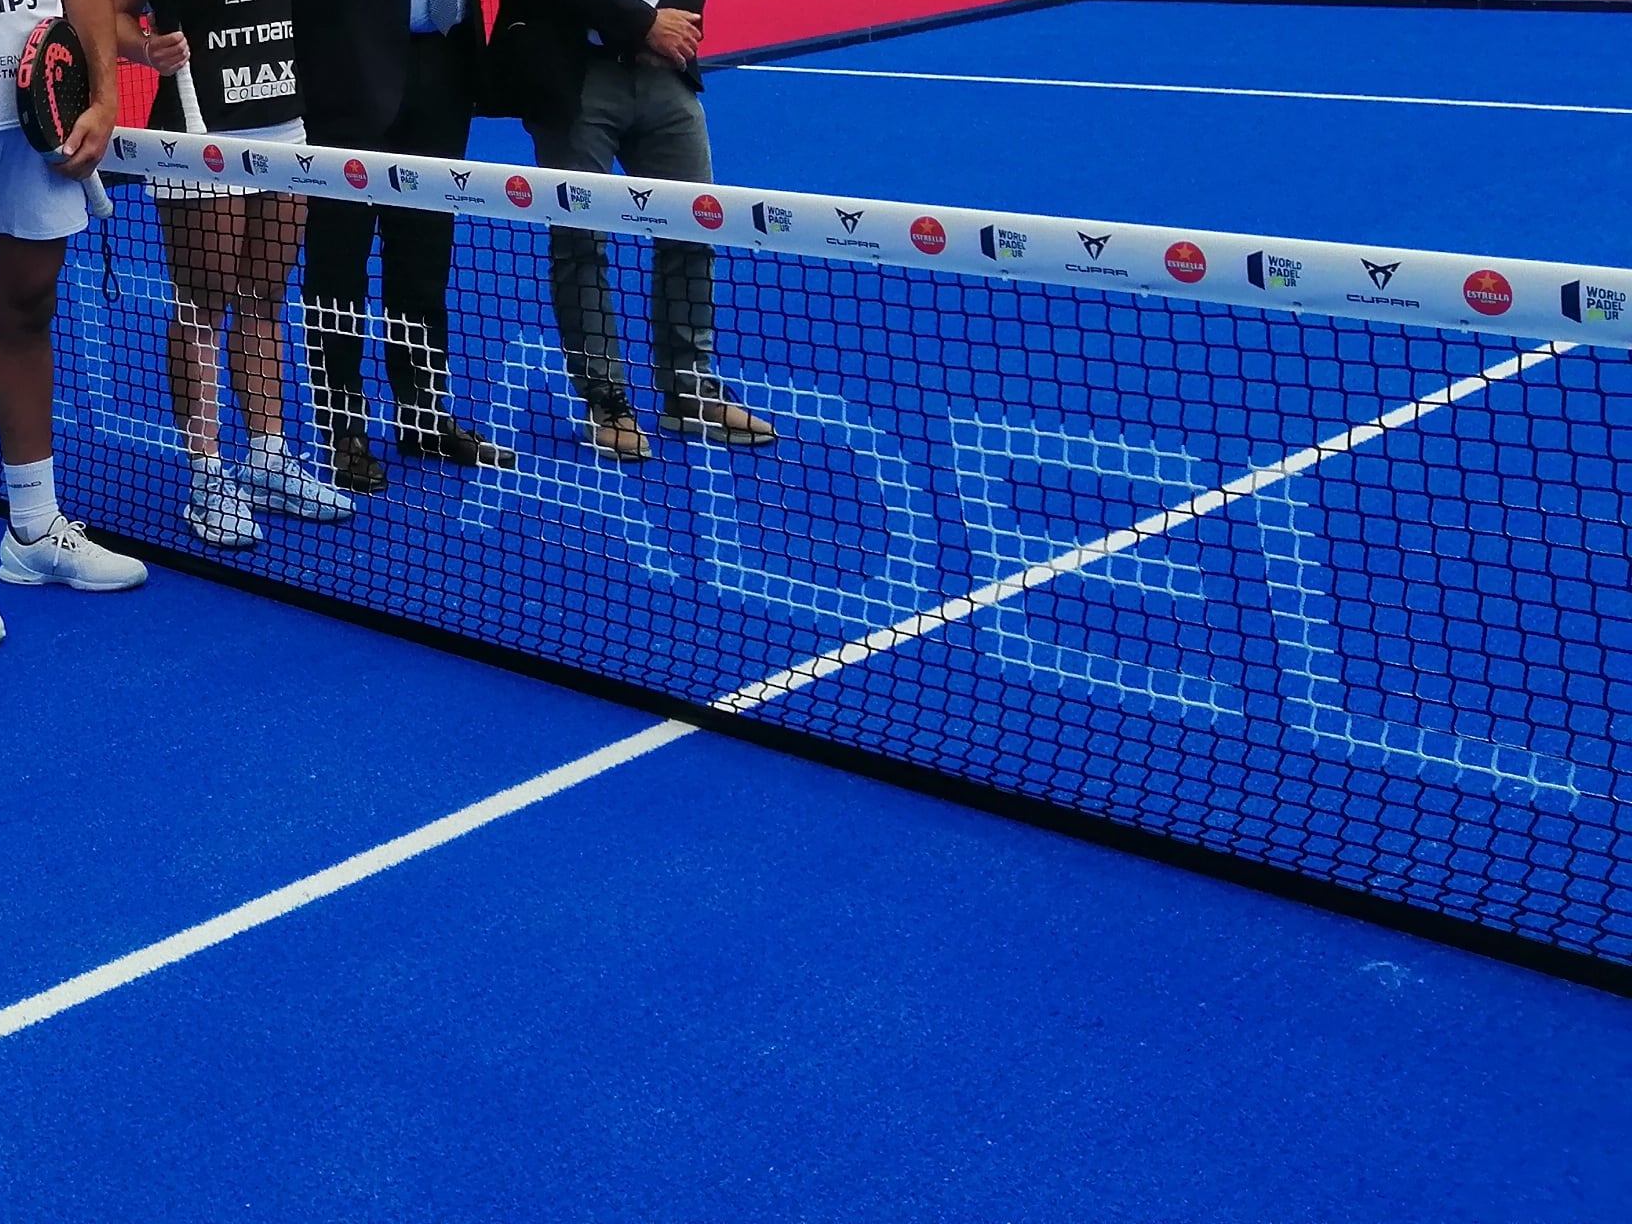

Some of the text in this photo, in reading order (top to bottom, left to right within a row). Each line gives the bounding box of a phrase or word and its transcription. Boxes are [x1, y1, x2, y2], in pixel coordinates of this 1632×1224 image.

[208, 26, 255, 50] NTT
[222, 60, 295, 88] MAX
[291, 176, 328, 187] CUPRA
[569, 185, 592, 197] WORLD
[444, 194, 486, 205] CUPRA
[695, 210, 723, 220] ESTRELLA
[767, 205, 793, 218] WORLD
[621, 214, 669, 226] CUPRA
[768, 215, 792, 226] PADEL
[912, 233, 945, 244] ESTRELLA
[998, 229, 1027, 243] WORLD
[826, 237, 881, 250] CUPRA
[999, 239, 1026, 251] PADEL
[1167, 259, 1206, 272] ESTRELLA
[1267, 255, 1303, 271] WORLD
[1065, 263, 1129, 278] CUPRA
[1268, 267, 1301, 280] PADEL
[1466, 289, 1511, 303] ESTRELLA
[1586, 286, 1627, 302] WORLD
[1346, 294, 1421, 309] CUPRA
[1586, 298, 1625, 312] PADEL
